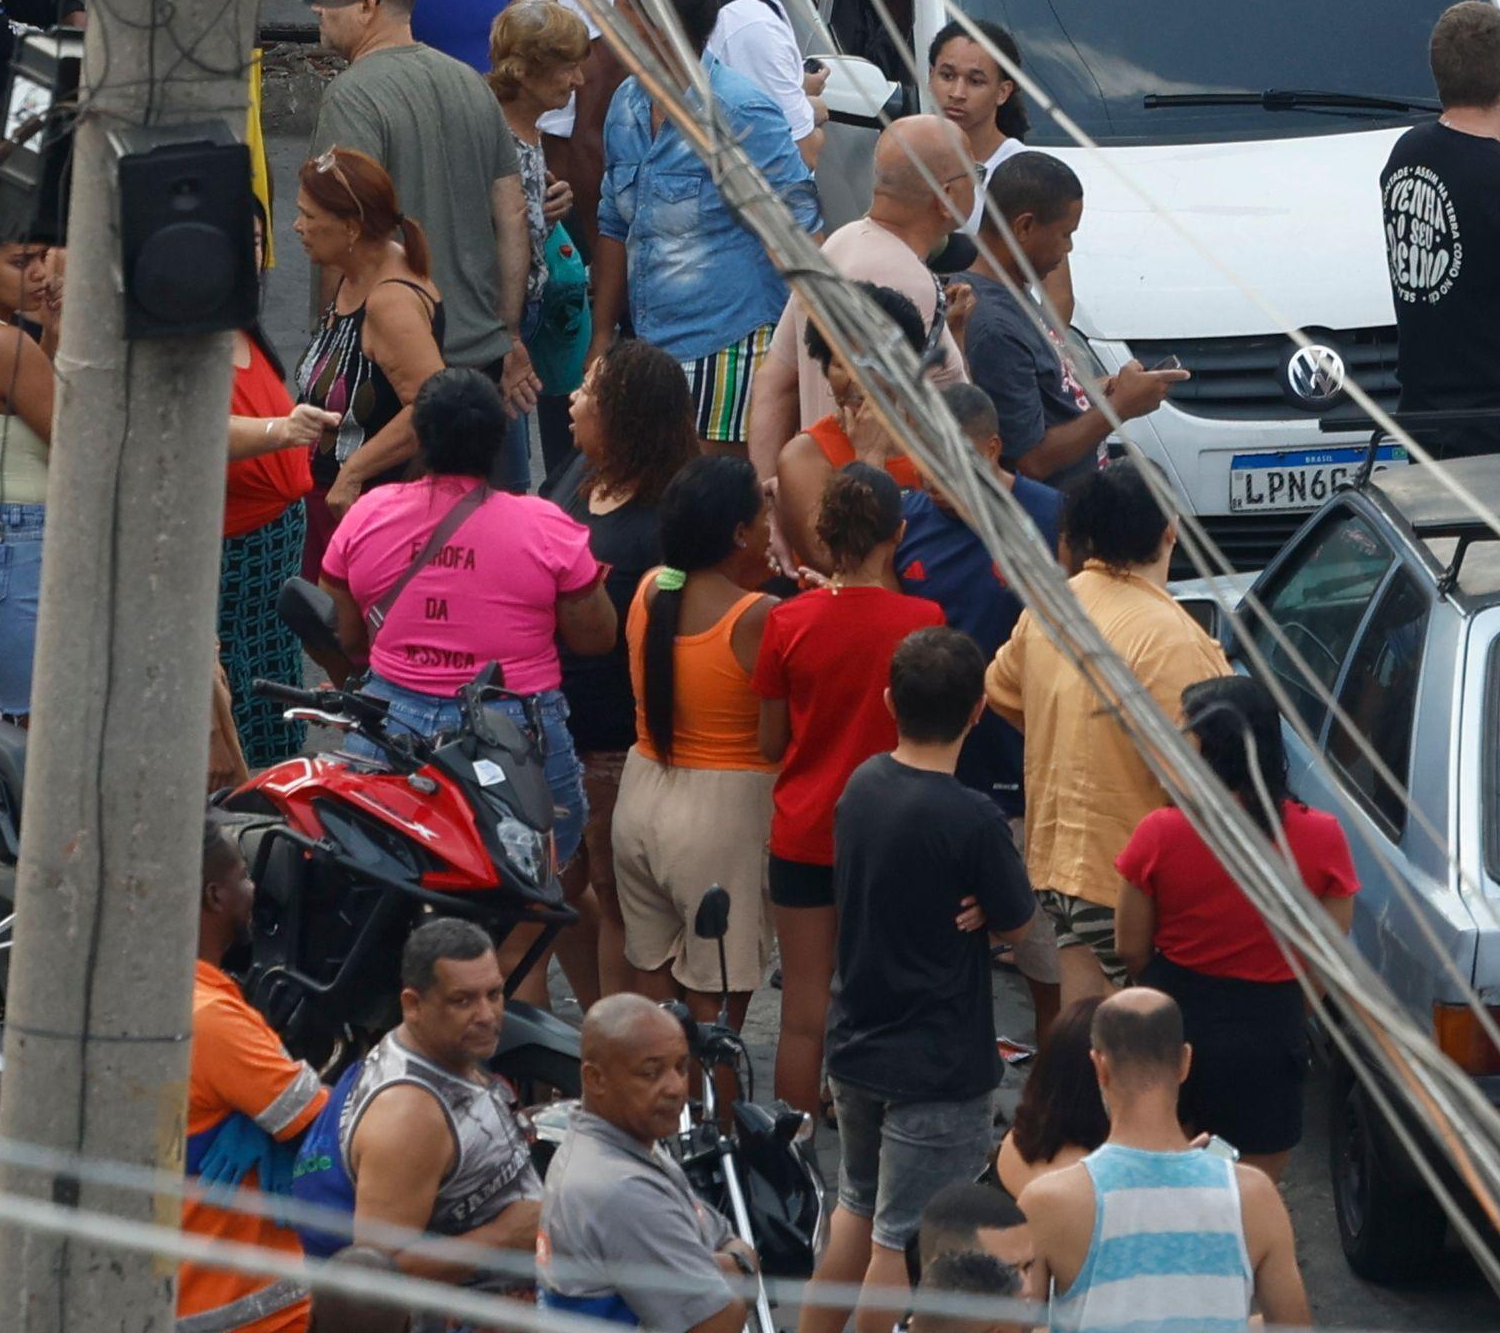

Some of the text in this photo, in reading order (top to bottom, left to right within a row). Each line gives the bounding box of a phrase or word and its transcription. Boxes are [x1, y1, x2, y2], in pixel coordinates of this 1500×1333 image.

[1414, 165, 1439, 186] ASSIM
[1437, 182, 1449, 201] NA
[1390, 178, 1447, 234] VENHA
[1397, 213, 1434, 250] O SEU
[1445, 200, 1461, 239] TERRA
[1387, 222, 1450, 289] REINO
[1449, 242, 1463, 278] COMO
[1440, 278, 1454, 295] NO
[1305, 454, 1334, 464] BRASIL
[425, 598, 448, 622] DA
[405, 644, 475, 670] JESSYCA
